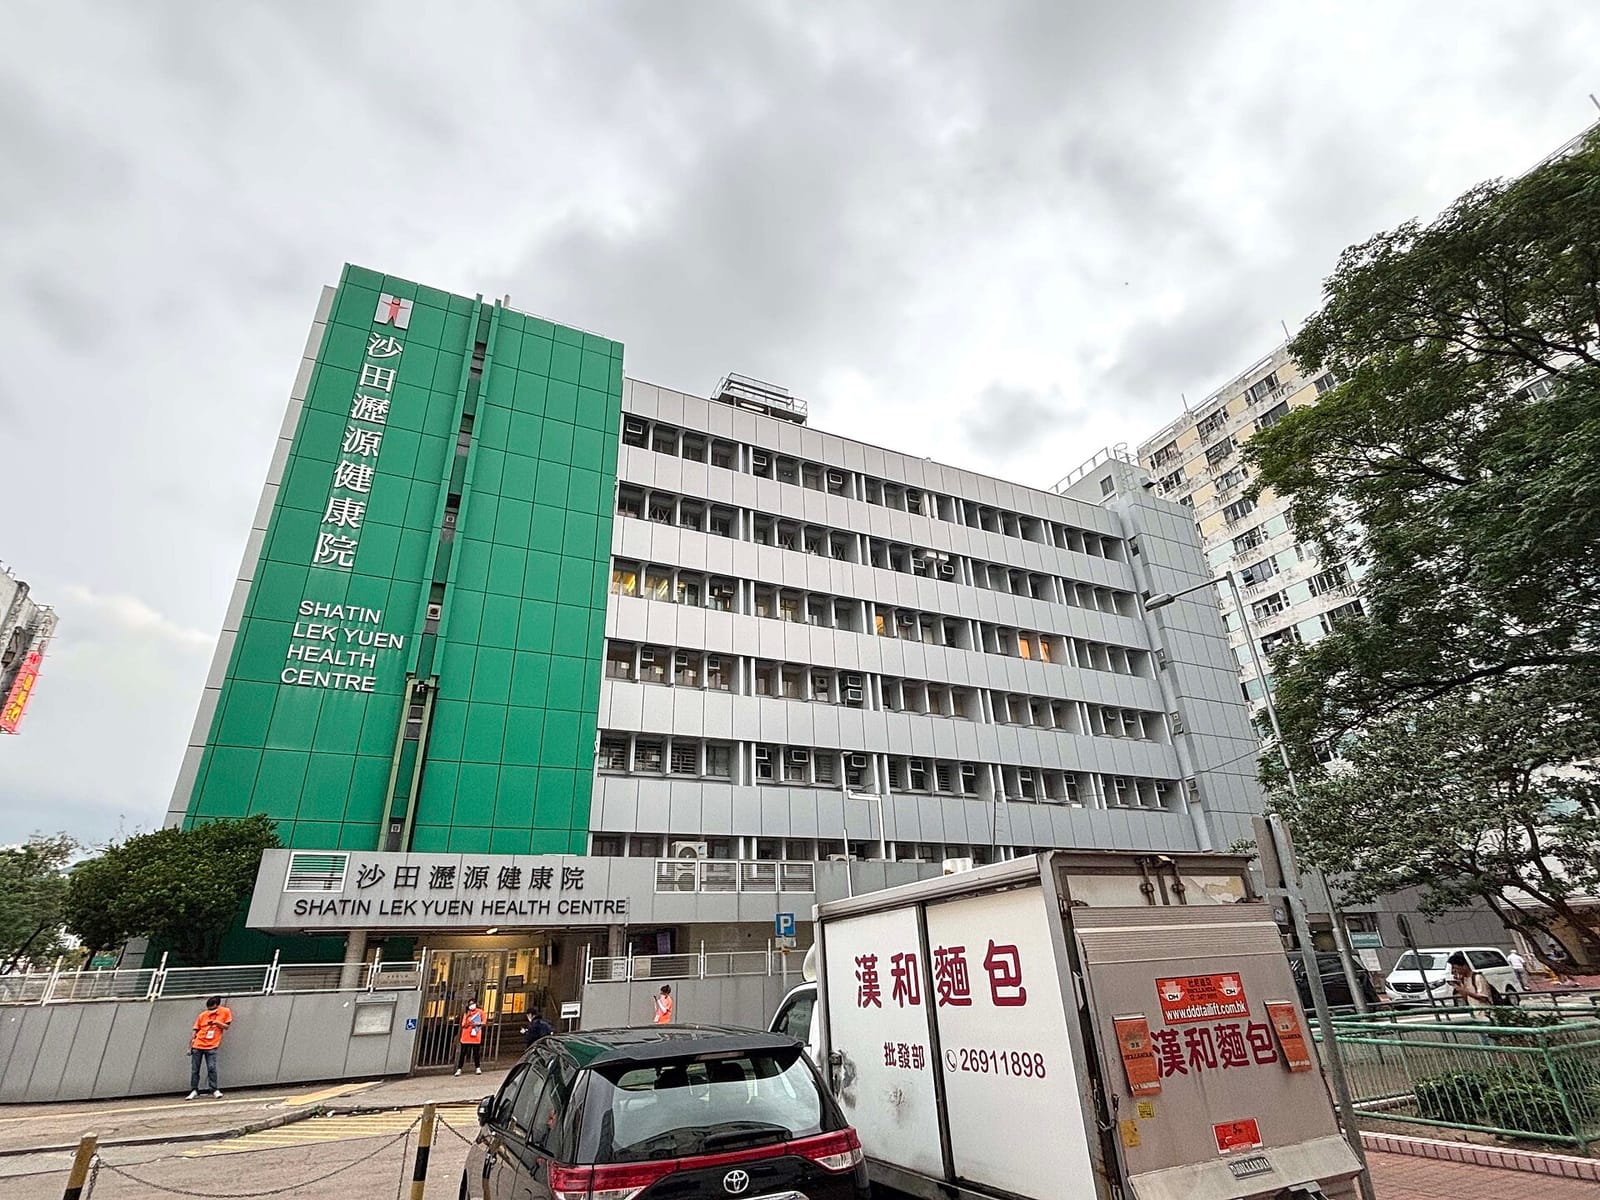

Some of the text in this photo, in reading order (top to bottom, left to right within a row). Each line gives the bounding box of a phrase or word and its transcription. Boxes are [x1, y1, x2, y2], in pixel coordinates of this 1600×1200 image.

[312, 331, 403, 568] 沙田瀝源健康院
[299, 600, 381, 624] SHATIN
[293, 622, 404, 649] LEK YUEN
[286, 643, 376, 669] HEALTH
[281, 667, 377, 692] CENTRE
[356, 864, 585, 891] 沙田瀝源健康院
[293, 898, 625, 916] SHATIN LEK YUEN HEALTH CENTRE
[780, 915, 792, 934] P
[855, 939, 1027, 1008] 漢和麵包
[884, 1041, 1046, 1079] 批發部 26911898
[1150, 1020, 1278, 1079] 漢和麵包
